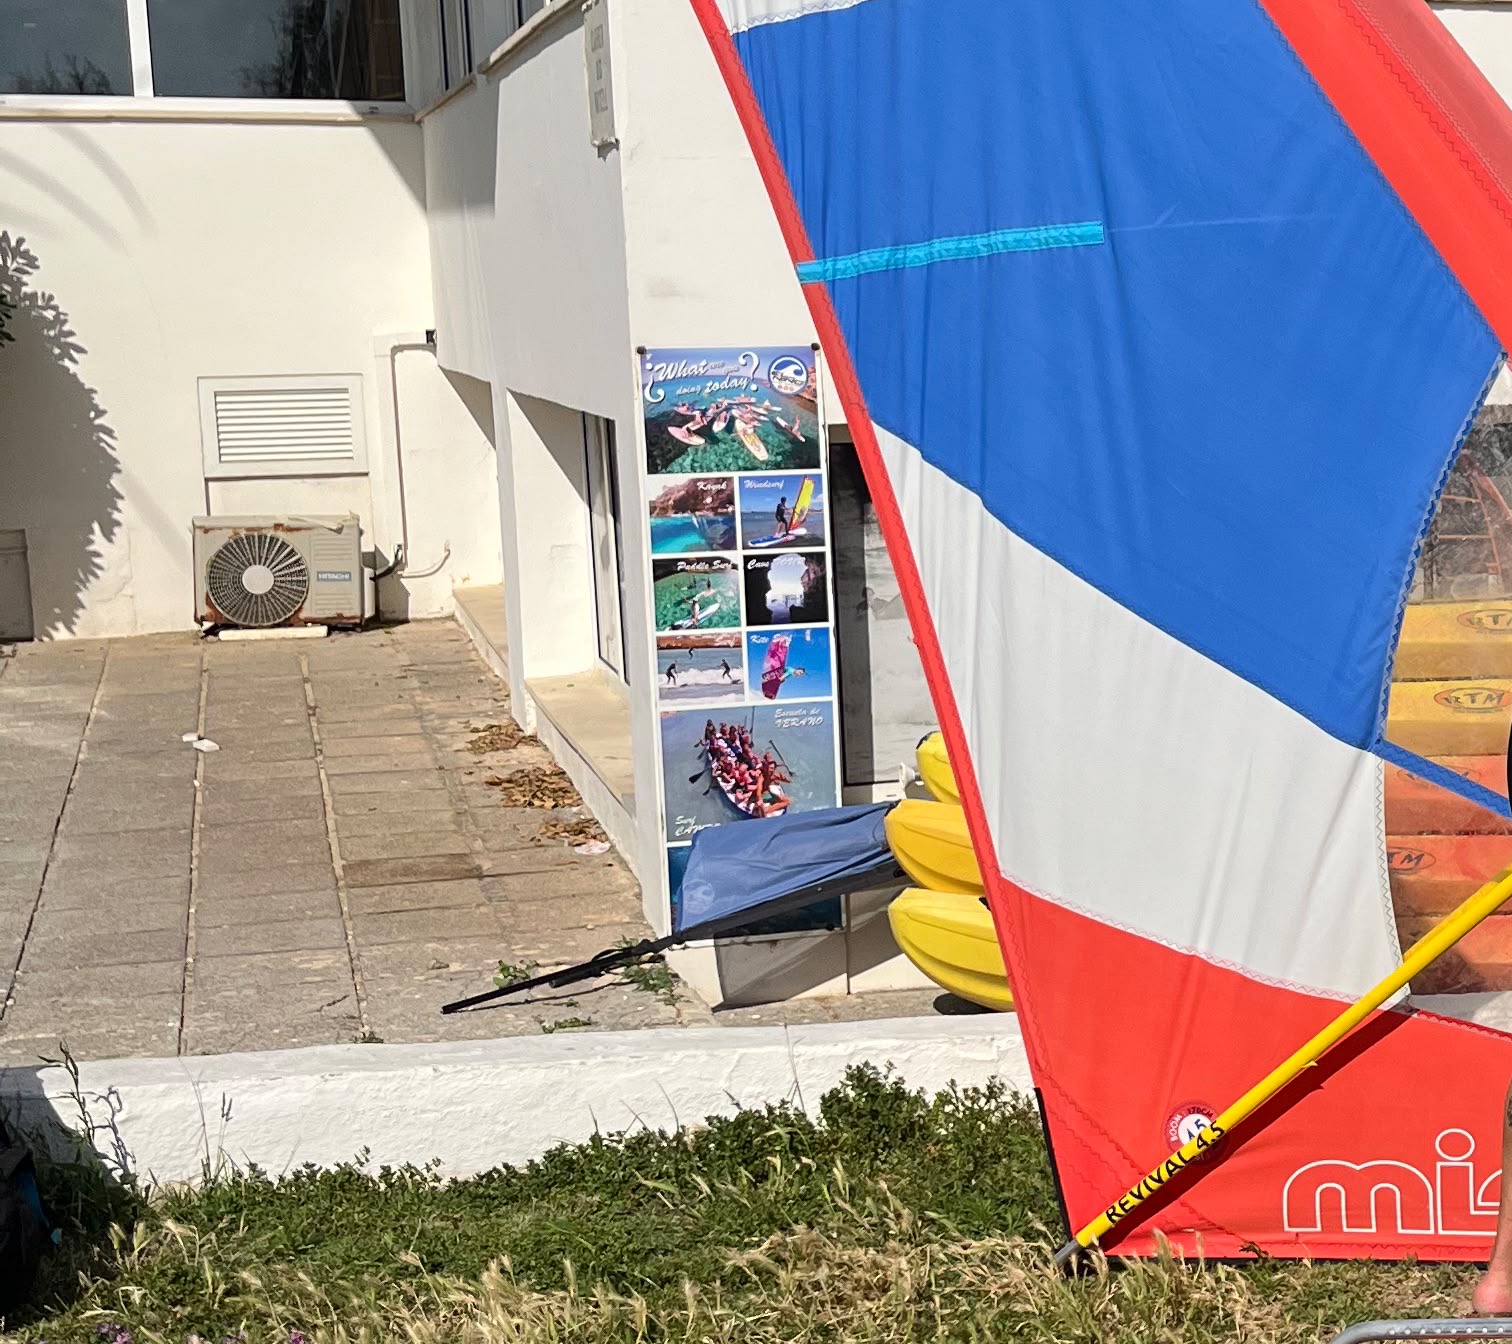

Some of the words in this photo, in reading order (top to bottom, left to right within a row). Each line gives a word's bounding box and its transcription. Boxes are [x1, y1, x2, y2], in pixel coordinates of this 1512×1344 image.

[696, 480, 727, 492] Kayak
[743, 479, 784, 490] Windsurf
[677, 560, 710, 571] Paddle
[1105, 1151, 1197, 1224] REVIVAL
